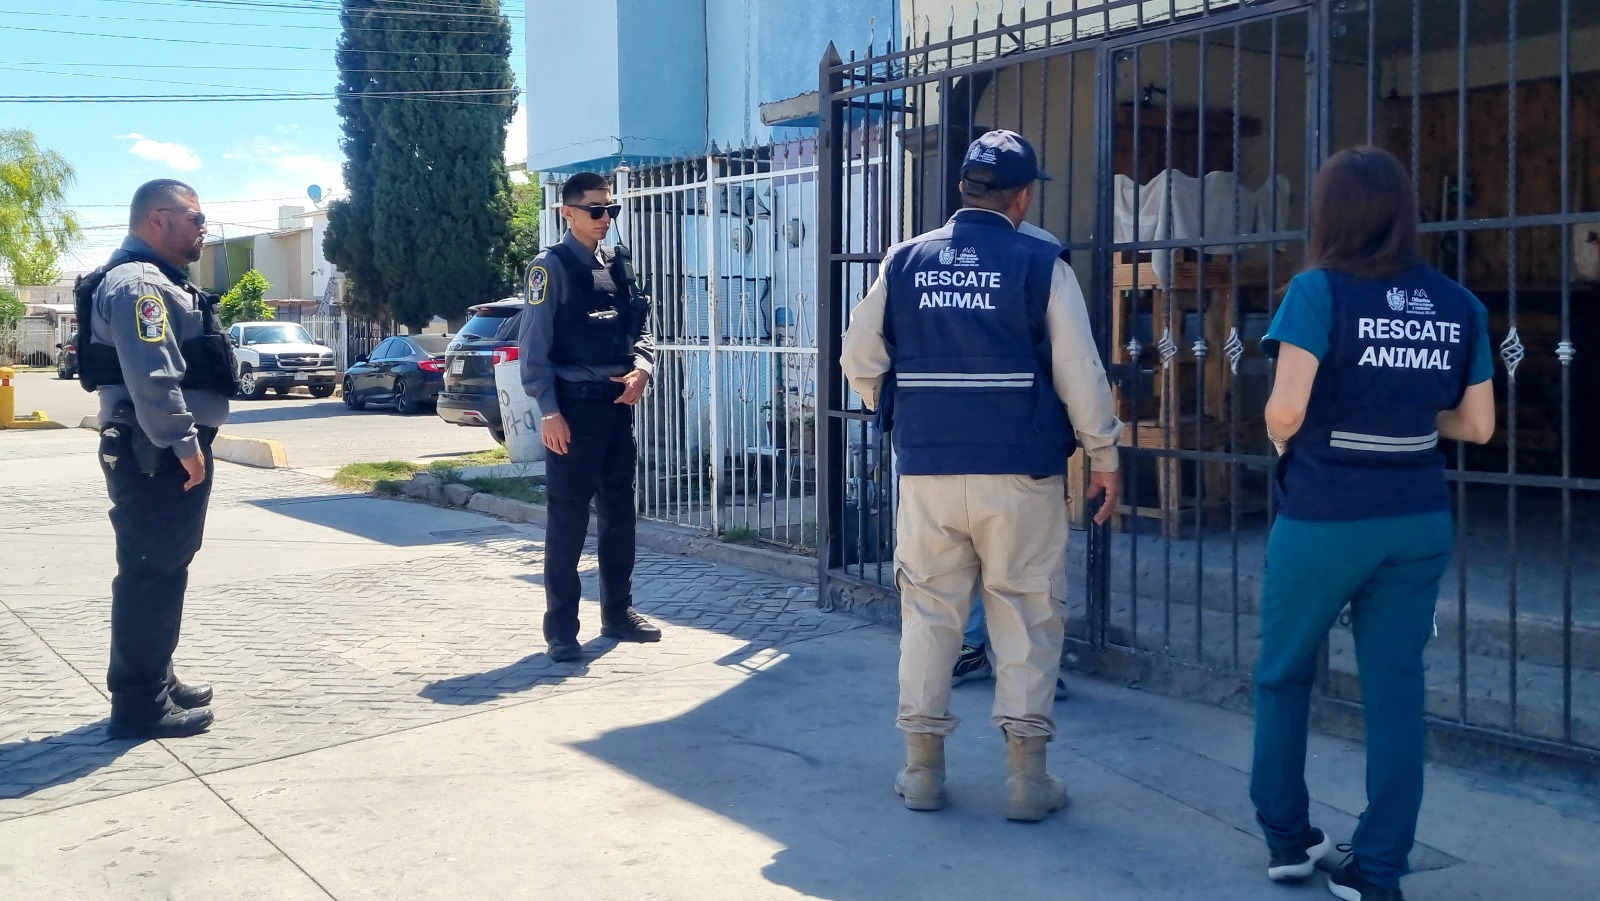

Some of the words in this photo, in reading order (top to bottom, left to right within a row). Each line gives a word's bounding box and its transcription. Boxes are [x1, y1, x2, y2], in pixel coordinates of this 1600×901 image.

[914, 270, 1001, 288] RESCATE
[918, 290, 996, 310] ANIMAL
[1358, 317, 1460, 343] RESCATE
[1357, 345, 1452, 370] ANIMAL
